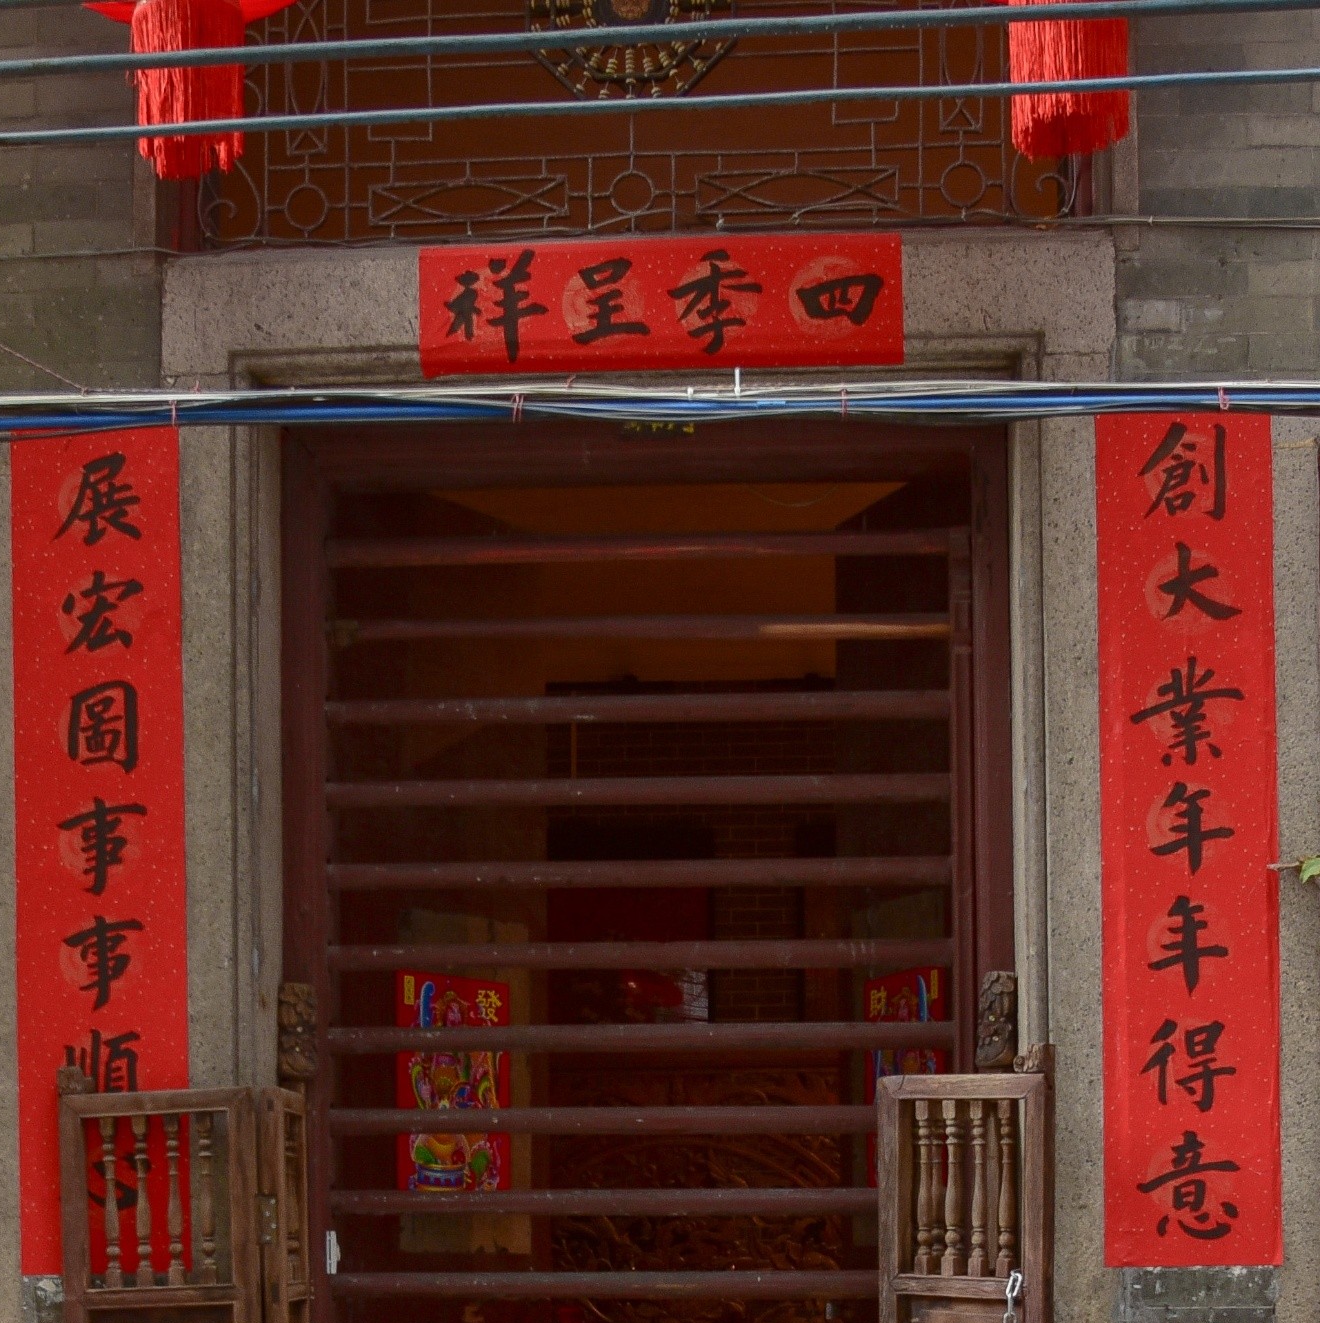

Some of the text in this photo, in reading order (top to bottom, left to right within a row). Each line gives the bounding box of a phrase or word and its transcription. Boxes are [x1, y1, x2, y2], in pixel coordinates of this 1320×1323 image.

[1130, 421, 1246, 1240] 創大業年年得意
